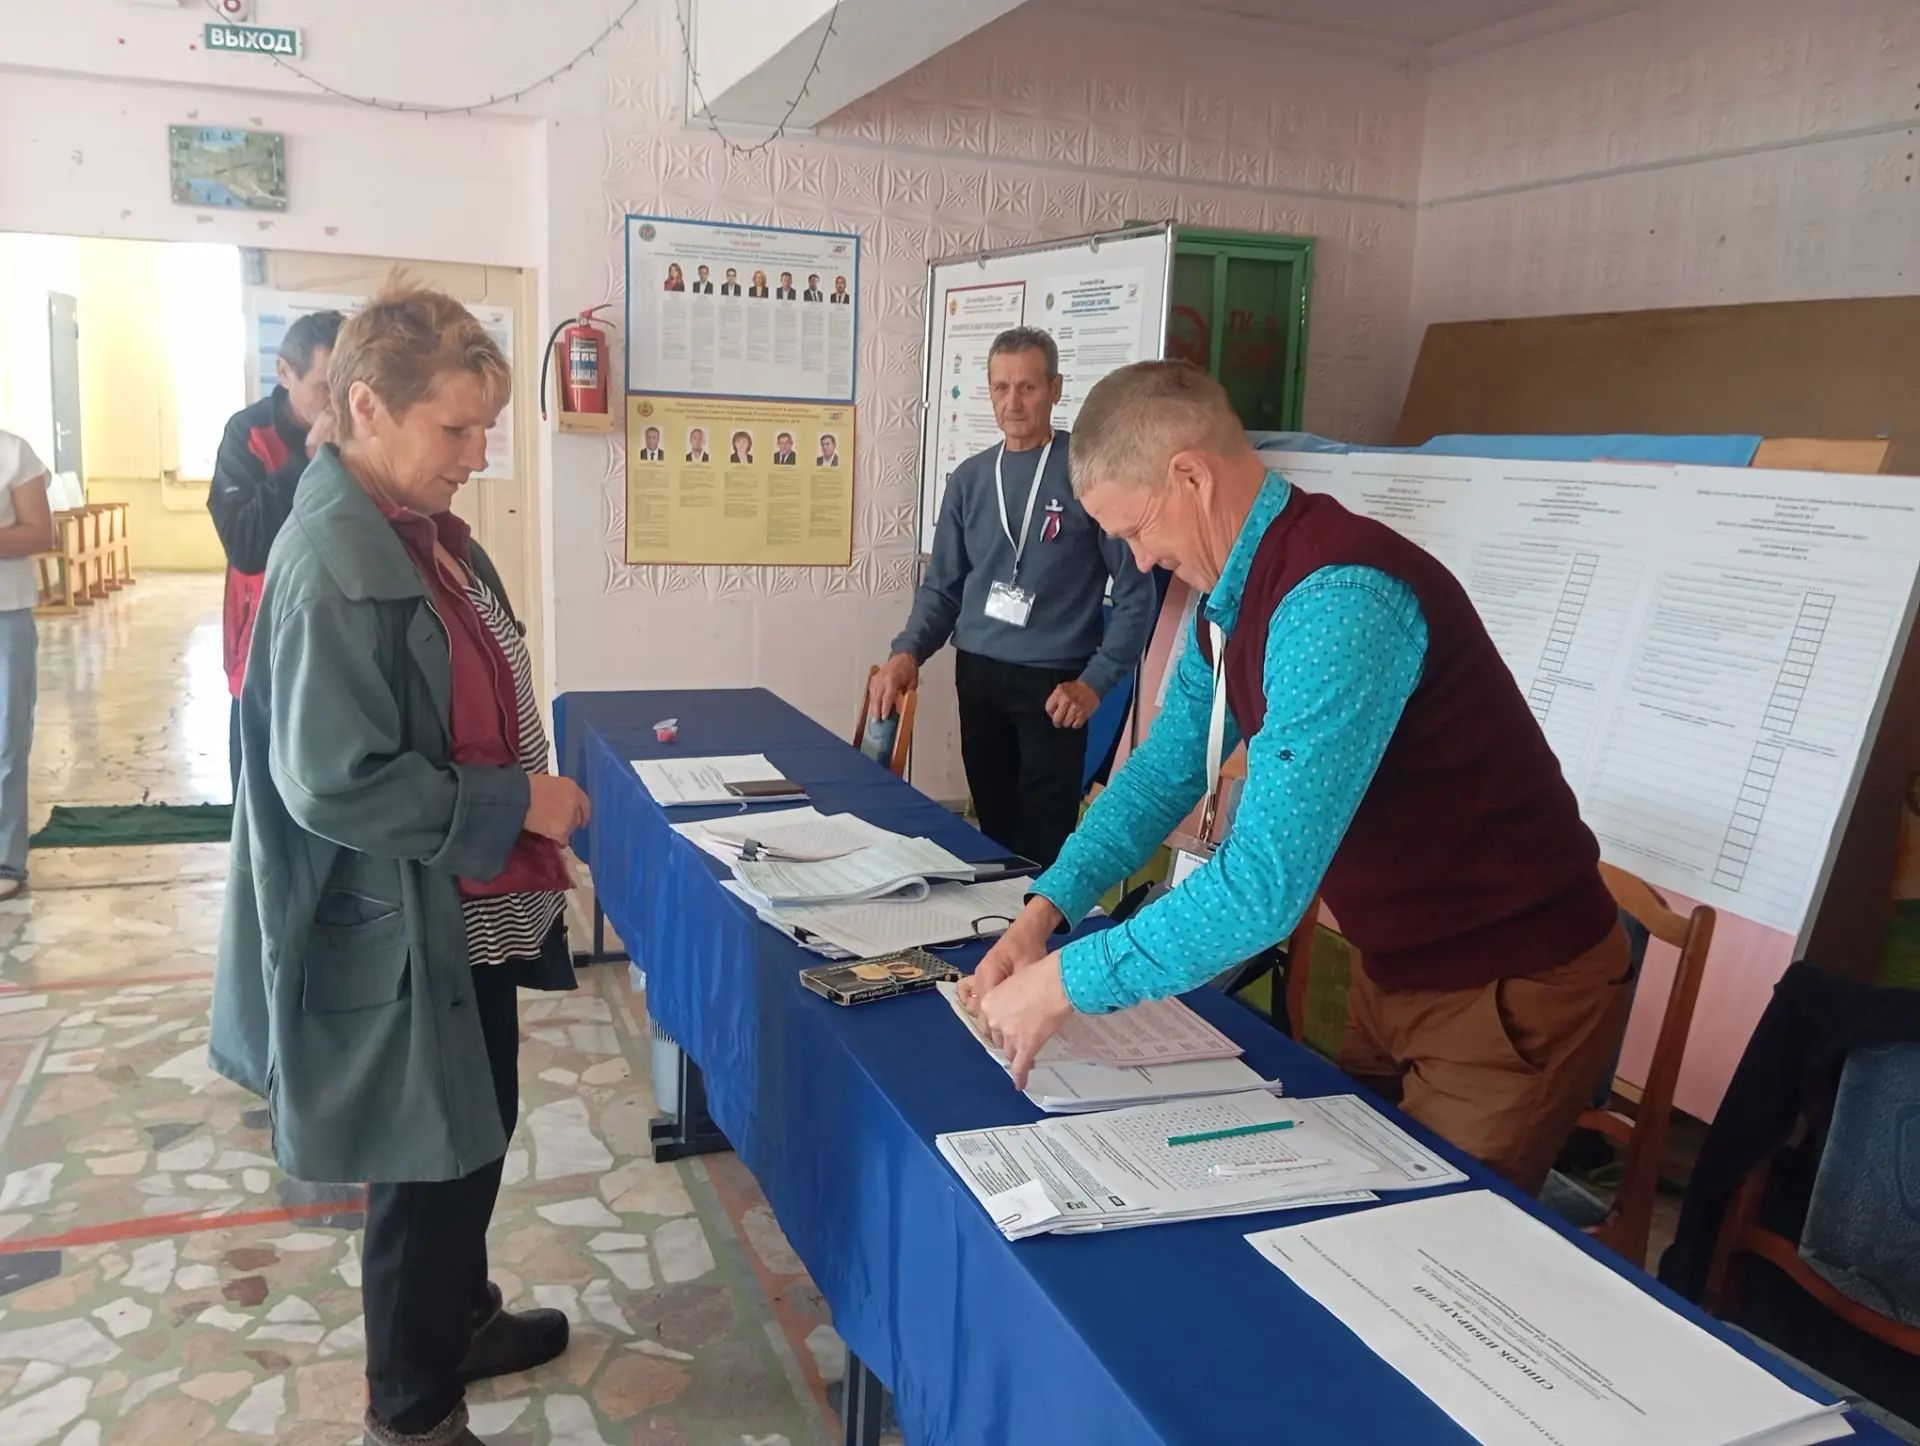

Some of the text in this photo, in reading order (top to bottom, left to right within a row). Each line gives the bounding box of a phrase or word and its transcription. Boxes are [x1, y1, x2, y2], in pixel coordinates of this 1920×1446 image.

[211, 28, 293, 53] ВЫХОД
[1410, 1285, 1503, 1349] ИЗБИРАТЕЛЕЙ
[1494, 1349, 1557, 1390] СПИСОК
